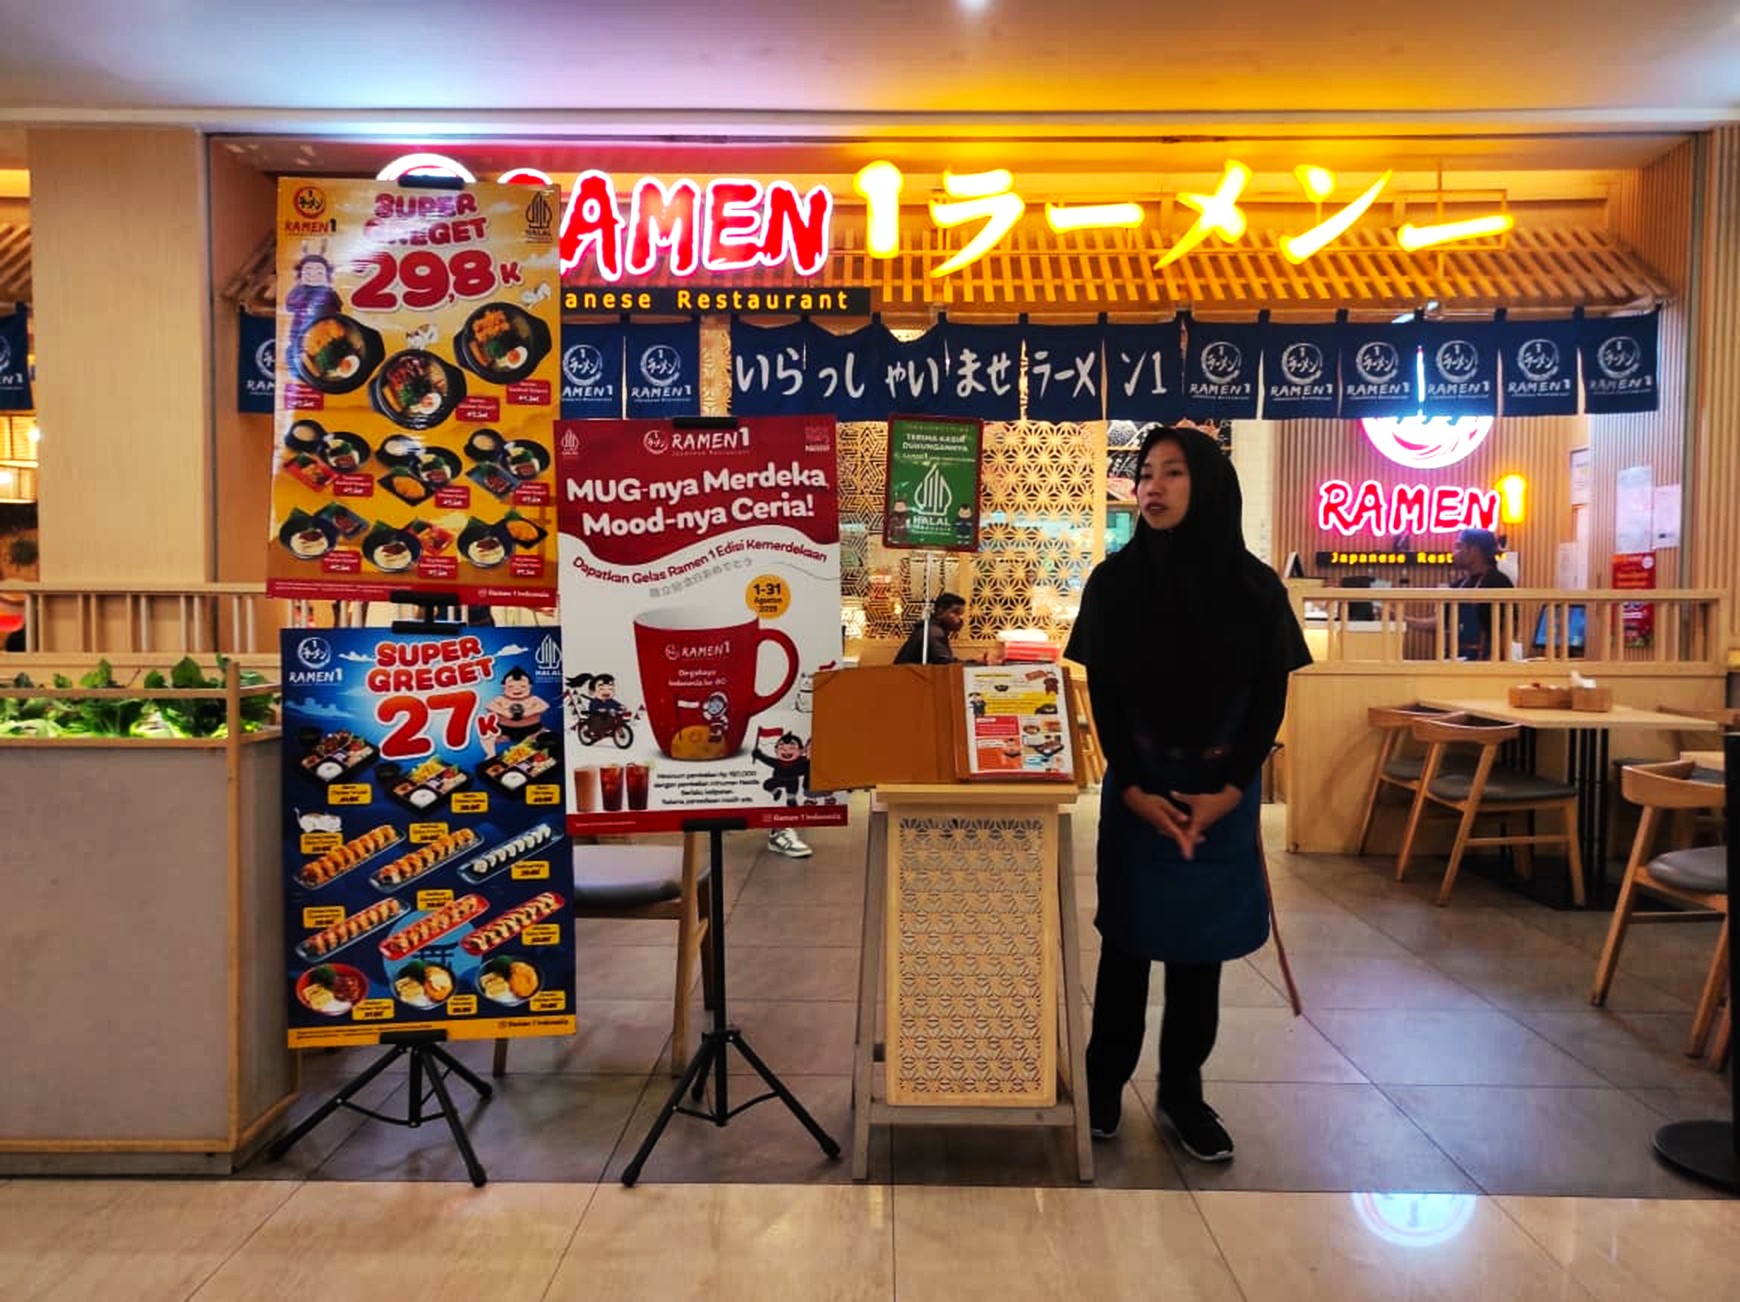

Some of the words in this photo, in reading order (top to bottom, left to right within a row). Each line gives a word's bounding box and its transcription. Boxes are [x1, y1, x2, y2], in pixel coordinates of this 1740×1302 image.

[374, 192, 478, 218] SUPER
[497, 167, 834, 281] AMEN
[563, 290, 652, 309] anese
[677, 289, 849, 310] Restaurant
[561, 384, 614, 397] AMEN1
[566, 477, 699, 505] MUG-nya
[582, 505, 728, 538] Mood-nya
[731, 490, 814, 522] Ceria!
[573, 555, 630, 586] Dapatkan
[631, 565, 667, 585] Gelas
[667, 554, 709, 576] Ramen
[716, 539, 745, 558] Edisi
[746, 539, 828, 563] Kemerdekaan
[1331, 551, 1406, 566] Japanese
[754, 582, 781, 596] 1-31
[376, 636, 481, 668] SUPER
[366, 657, 495, 693] GREGET
